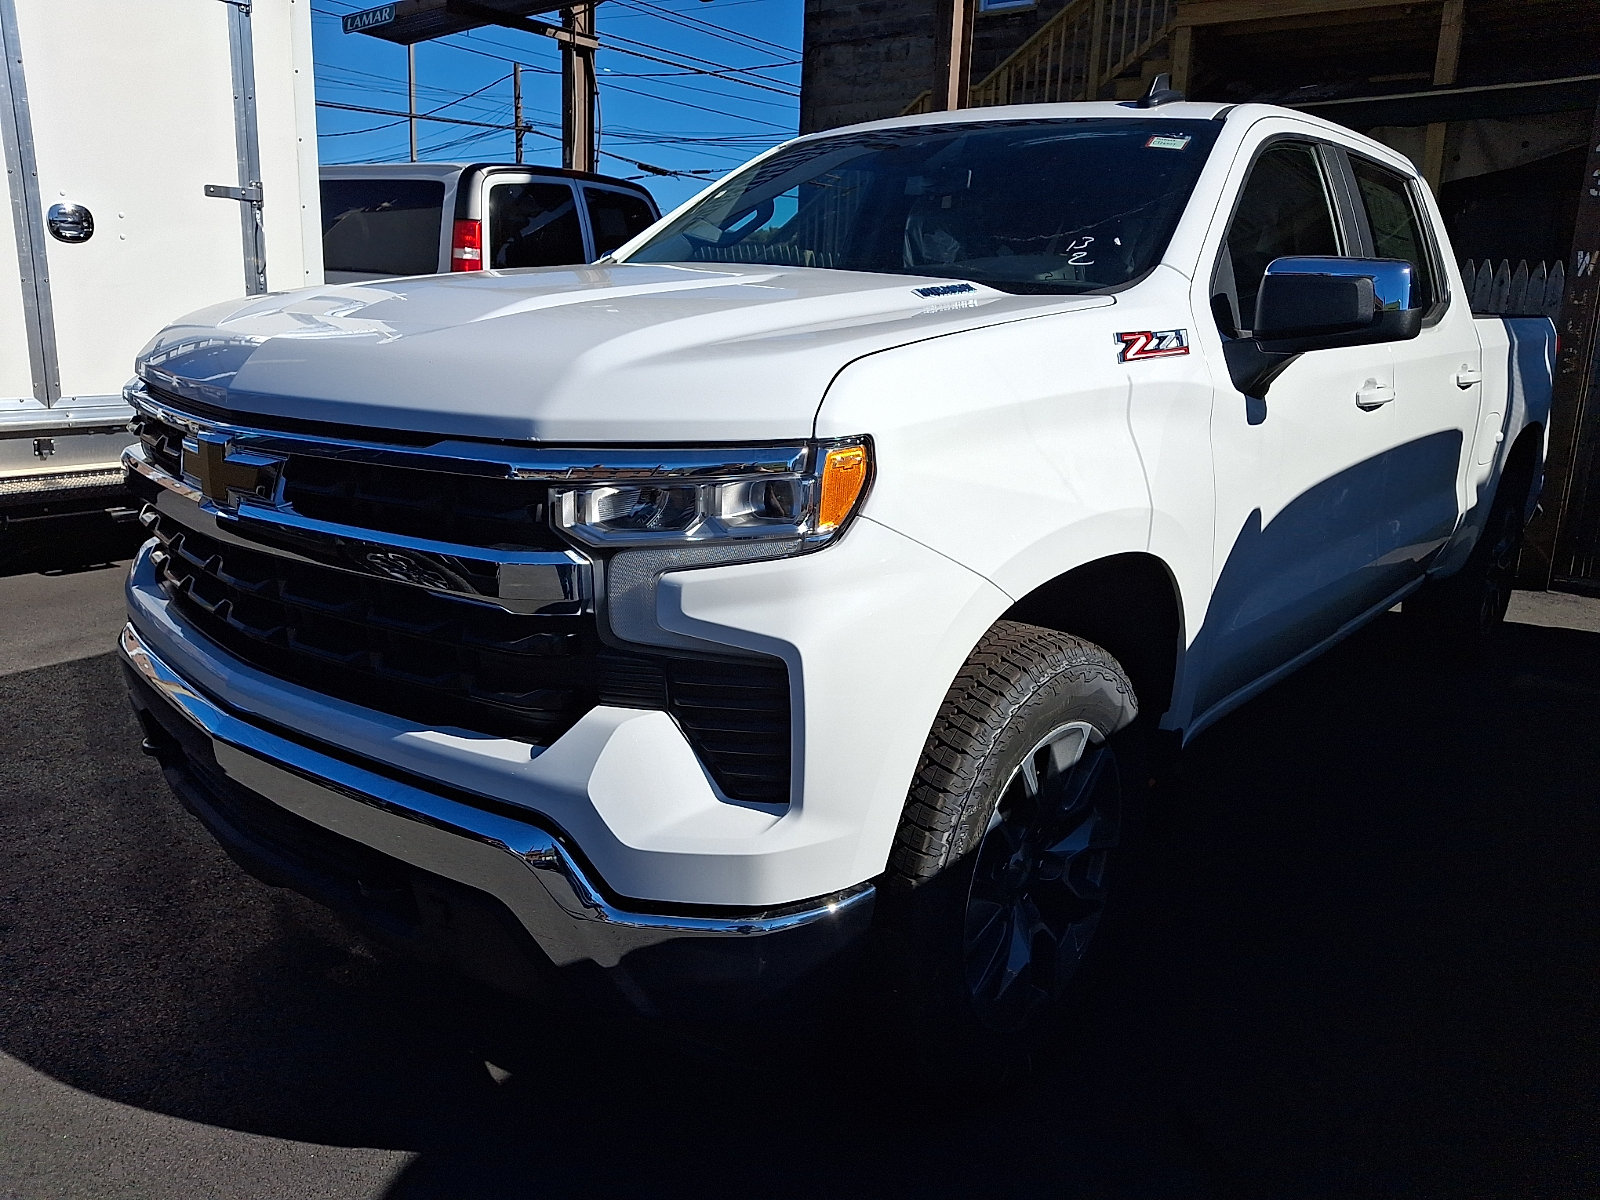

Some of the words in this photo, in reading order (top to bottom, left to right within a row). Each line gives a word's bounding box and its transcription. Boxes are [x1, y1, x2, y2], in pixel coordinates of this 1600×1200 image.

[347, 7, 390, 30] LAMAR
[1067, 251, 1095, 266] 2
[1113, 328, 1190, 364] Z71
